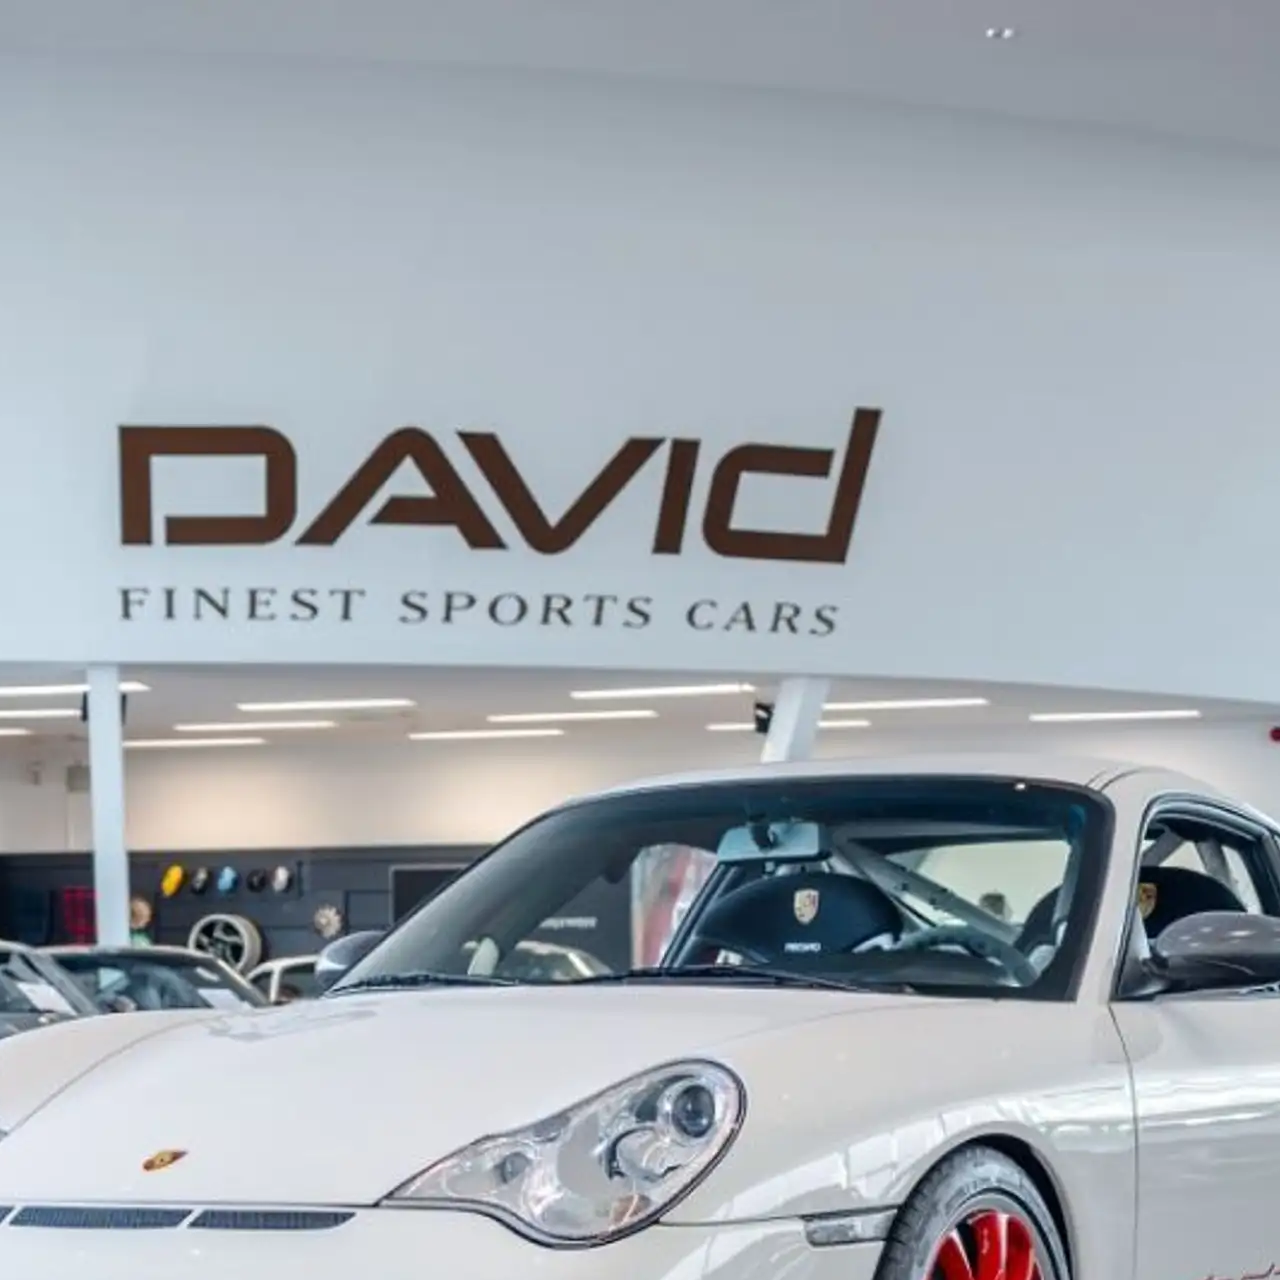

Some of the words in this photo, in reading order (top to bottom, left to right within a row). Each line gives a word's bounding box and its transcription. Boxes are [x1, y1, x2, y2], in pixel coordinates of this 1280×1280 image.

[117, 586, 366, 623] FINEST
[398, 590, 653, 629] SPORTS
[685, 598, 839, 637] CARS
